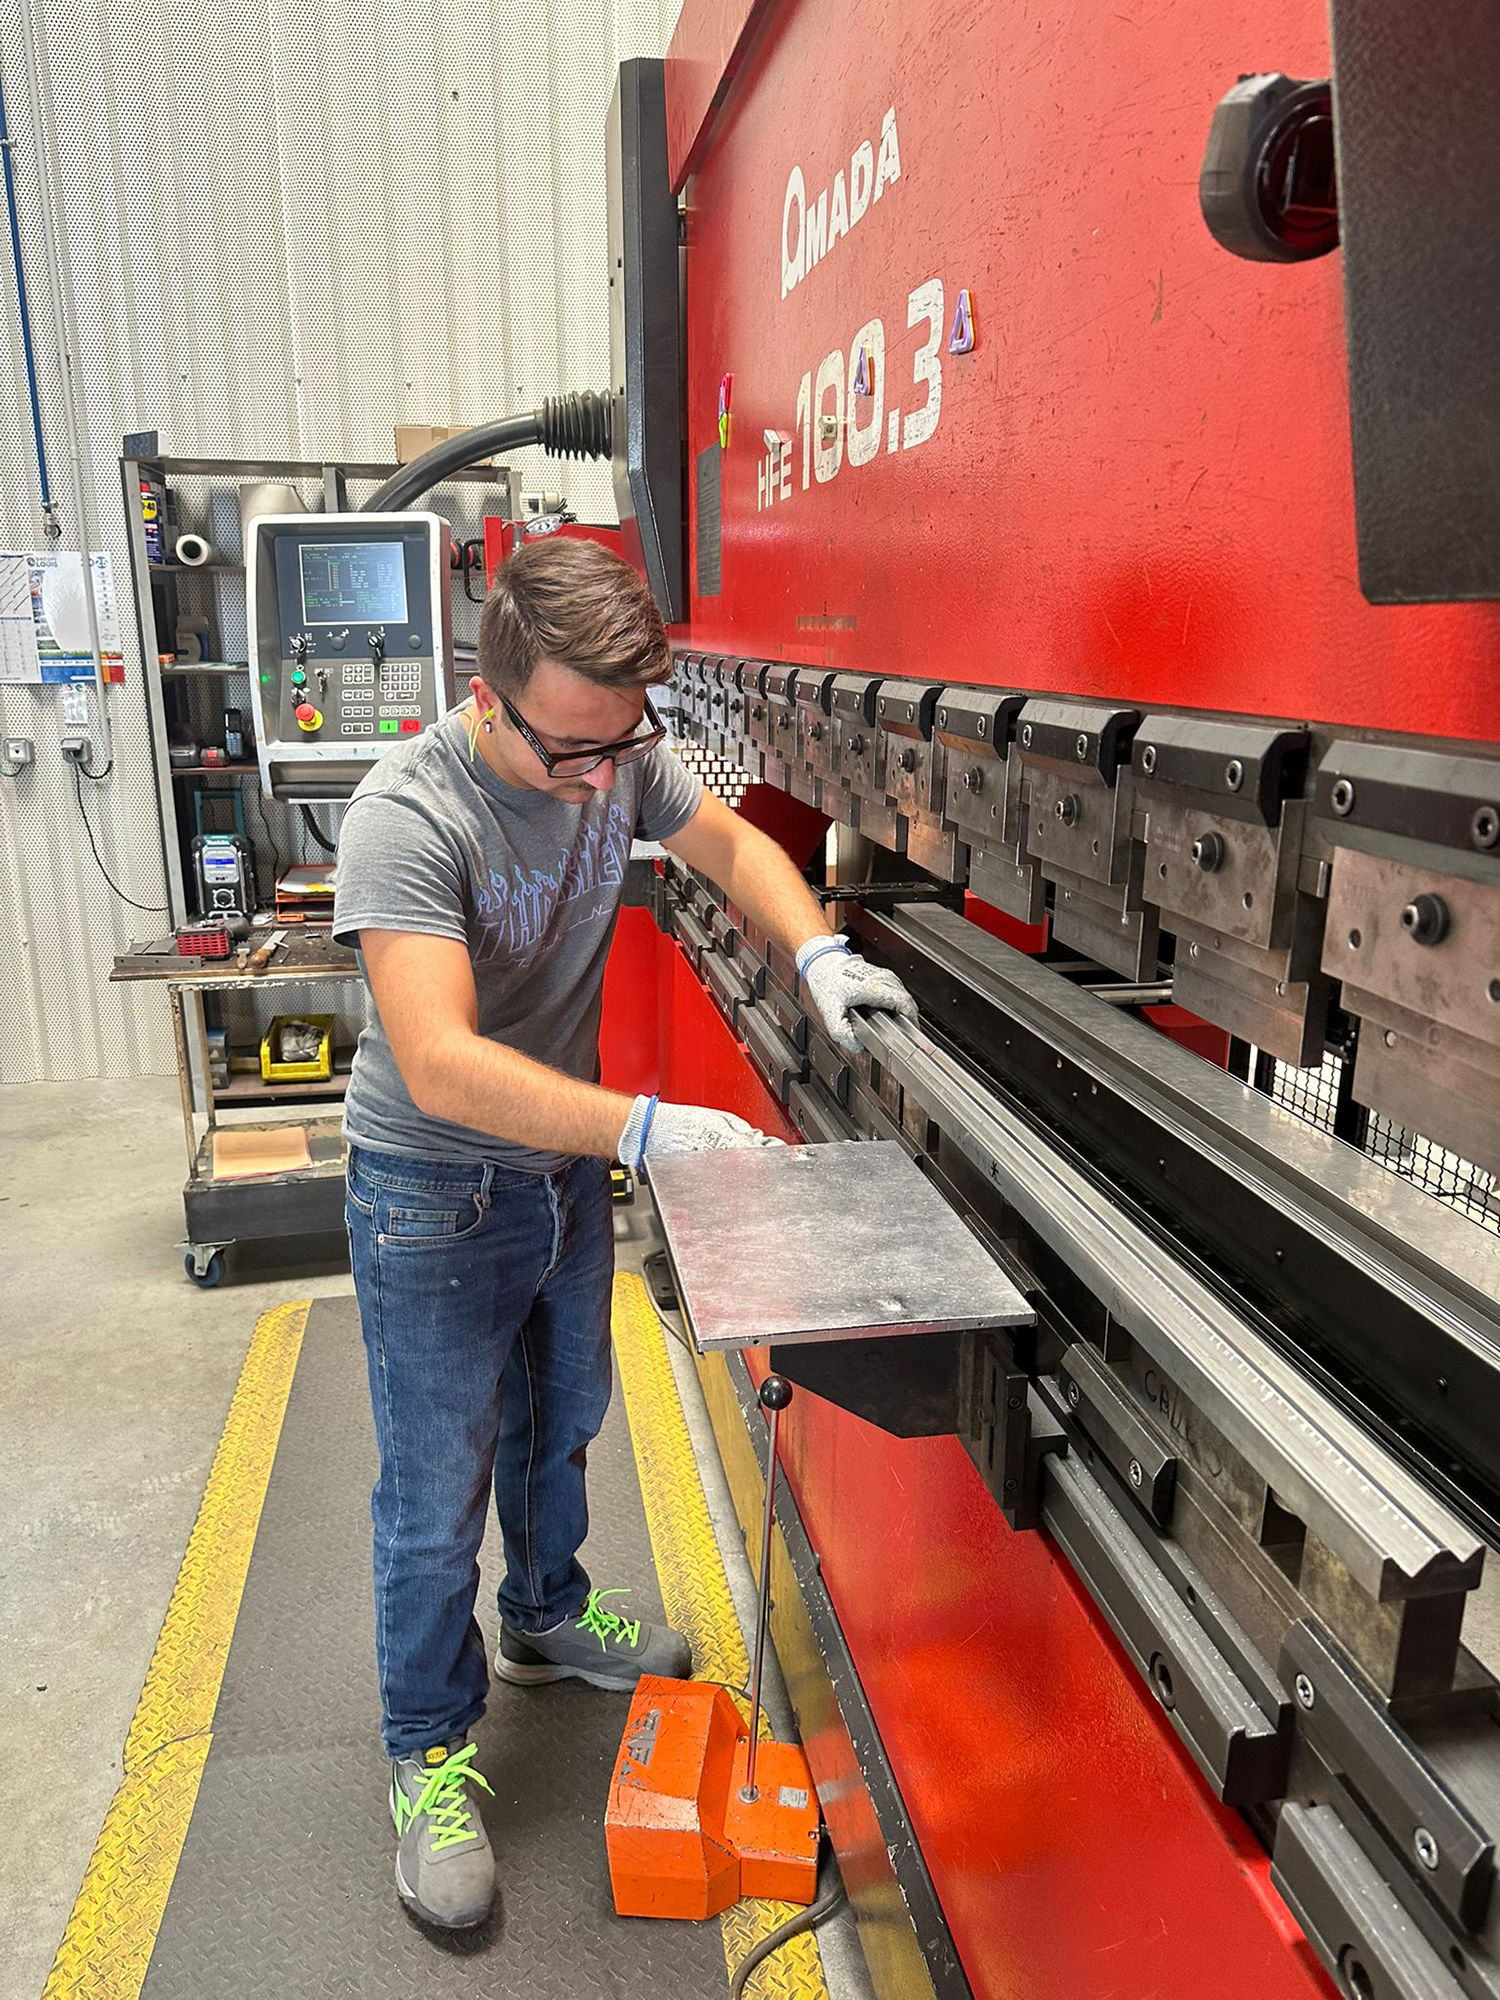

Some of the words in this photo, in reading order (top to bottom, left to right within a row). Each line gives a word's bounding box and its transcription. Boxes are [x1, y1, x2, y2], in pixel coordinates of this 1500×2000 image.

[757, 440, 792, 512] HFE
[796, 278, 944, 492] 100.3
[473, 804, 630, 963] THRSHE
